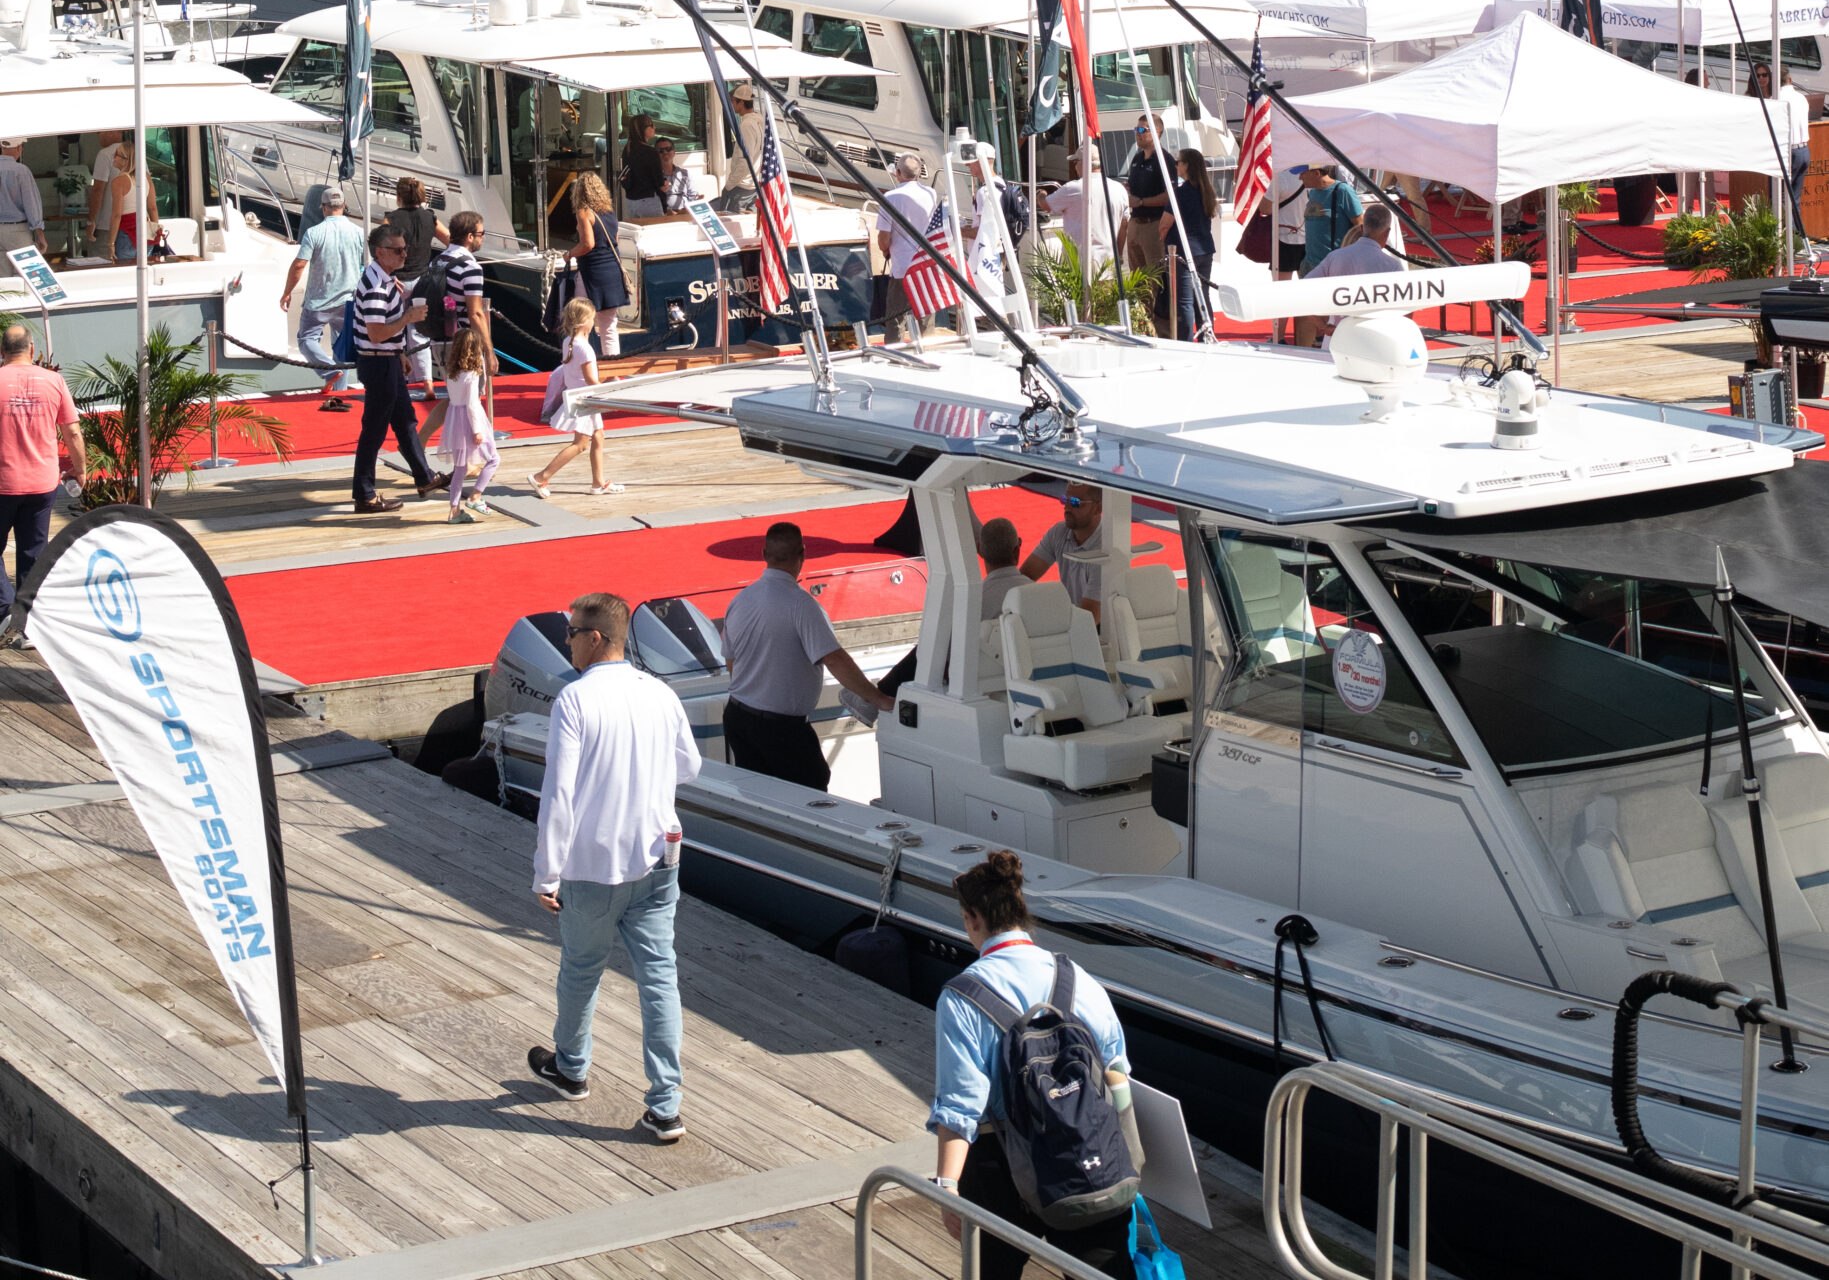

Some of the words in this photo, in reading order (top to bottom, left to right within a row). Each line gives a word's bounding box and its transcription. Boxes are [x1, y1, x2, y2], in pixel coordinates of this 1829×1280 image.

[1332, 279, 1445, 307] GARMIN
[129, 652, 271, 961] SPORTSMAN
[193, 853, 247, 964] BOATS
